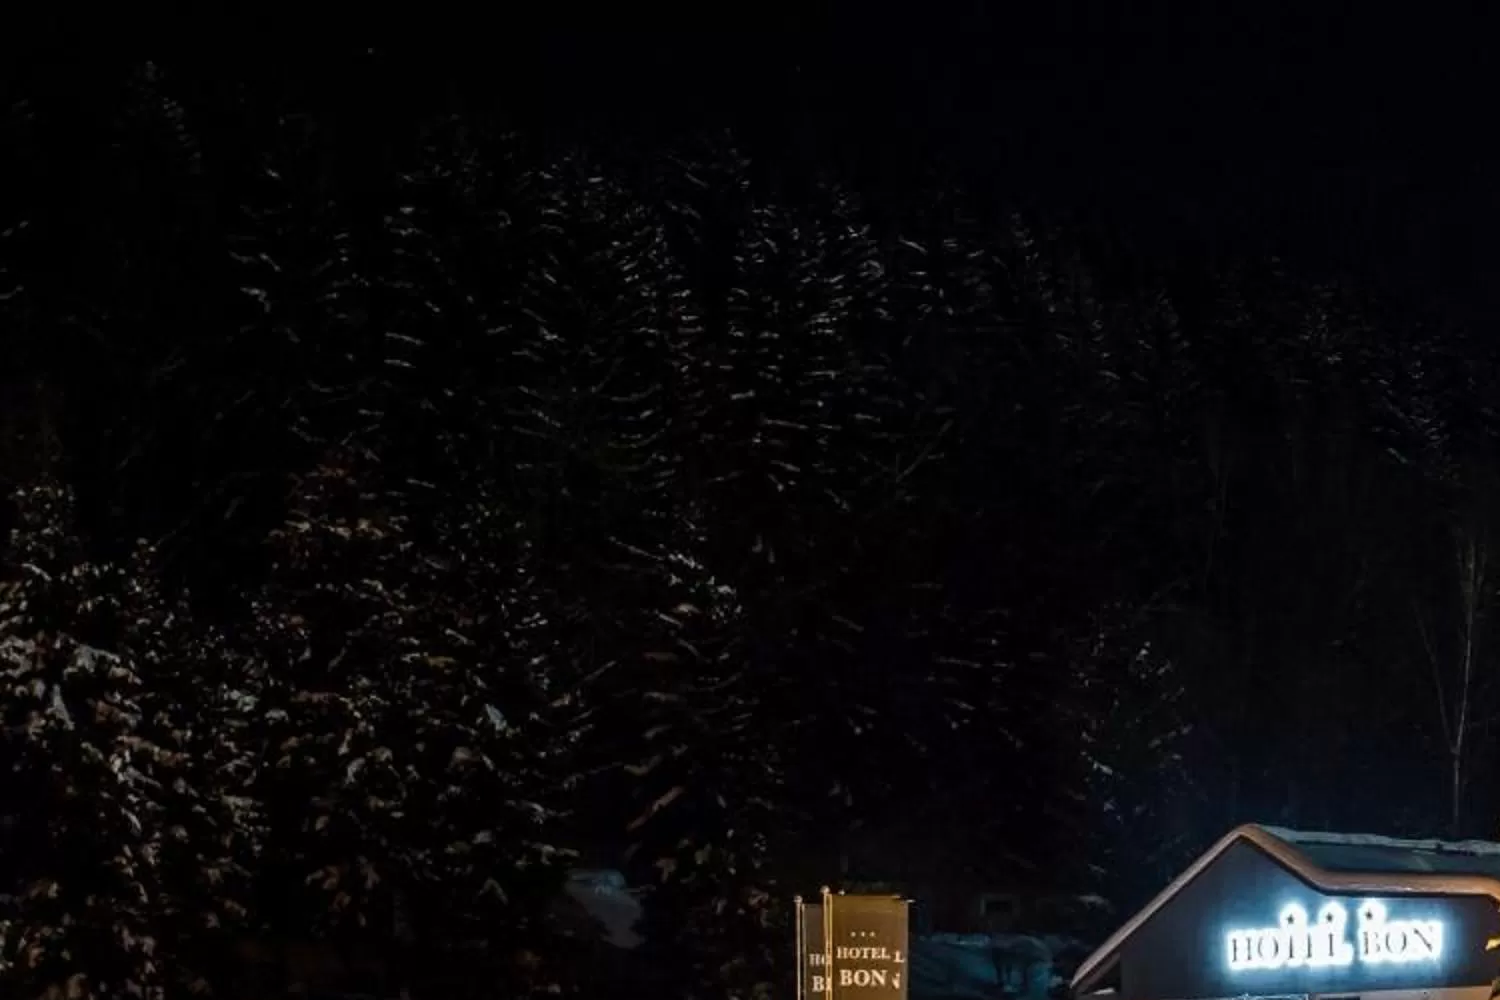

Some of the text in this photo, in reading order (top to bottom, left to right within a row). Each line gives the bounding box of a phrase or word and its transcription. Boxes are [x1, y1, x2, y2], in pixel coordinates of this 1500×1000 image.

[1361, 920, 1442, 962] BON
[837, 947, 890, 960] HOTEL
[840, 969, 887, 986] BON
